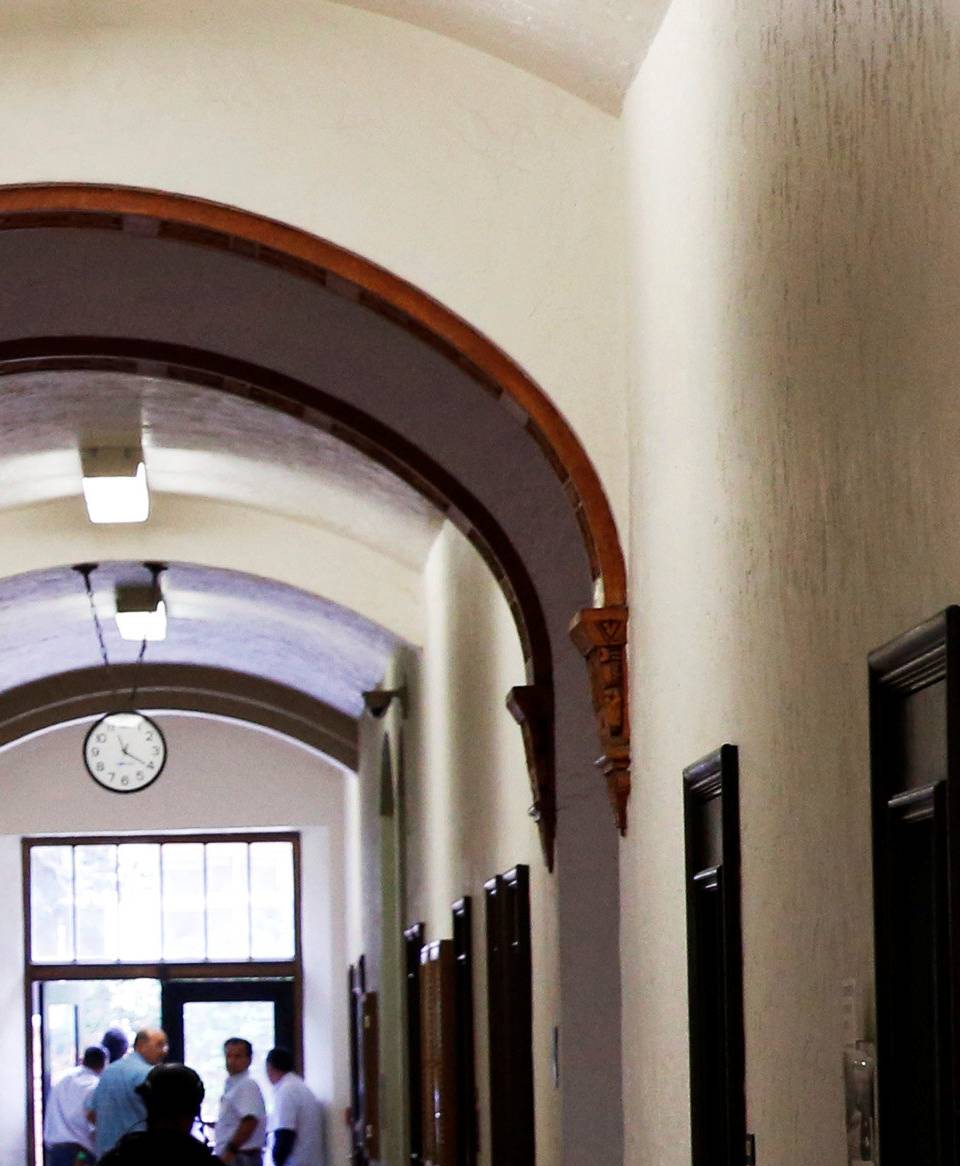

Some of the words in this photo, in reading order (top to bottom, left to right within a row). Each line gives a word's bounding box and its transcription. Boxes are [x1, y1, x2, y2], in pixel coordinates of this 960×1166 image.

[96, 733, 106, 743] 10
[146, 731, 153, 741] 2
[91, 747, 99, 757] 9
[152, 746, 160, 755] 3
[96, 761, 104, 771] 8
[146, 761, 154, 769] 4
[108, 772, 115, 782] 7
[121, 775, 129, 786] 6
[136, 771, 144, 780] 5
